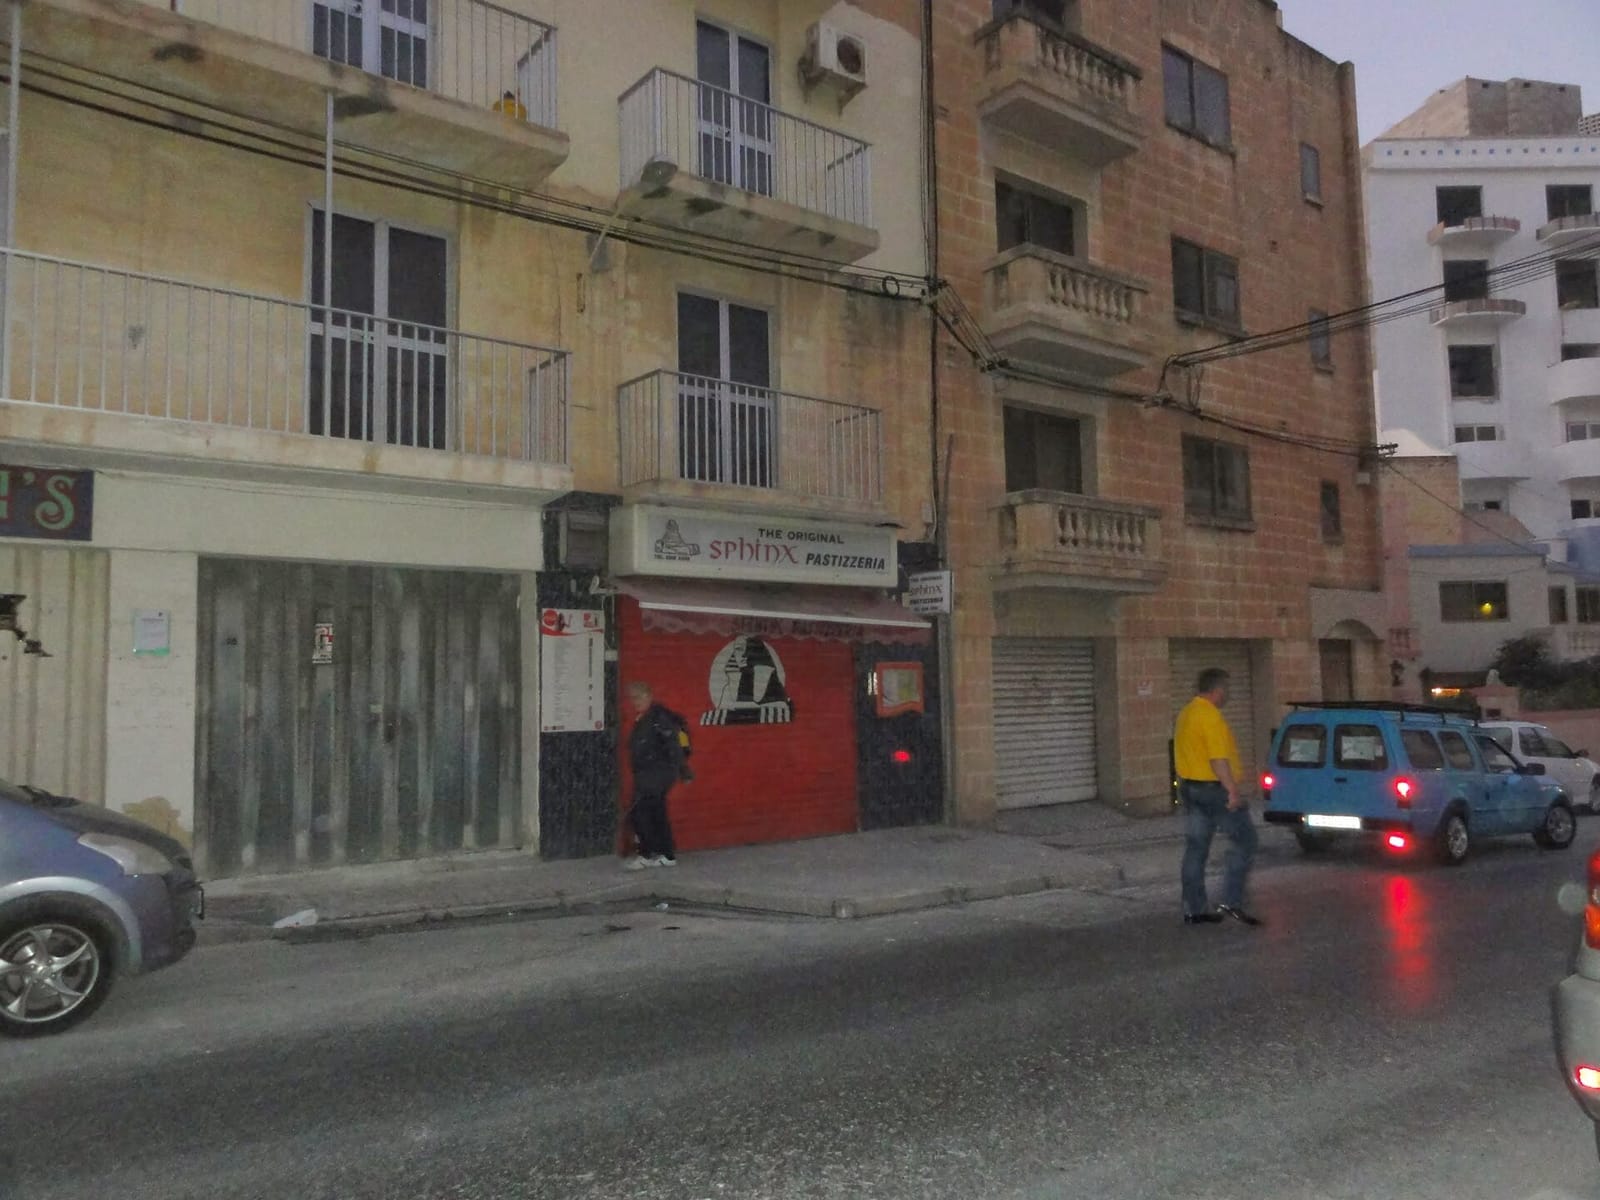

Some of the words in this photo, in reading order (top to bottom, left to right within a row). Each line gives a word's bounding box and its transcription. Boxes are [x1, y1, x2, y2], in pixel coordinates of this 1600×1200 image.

[758, 528, 783, 540] THE
[787, 531, 845, 545] ORIGINAL
[805, 552, 885, 570] PASTIZZERIA
